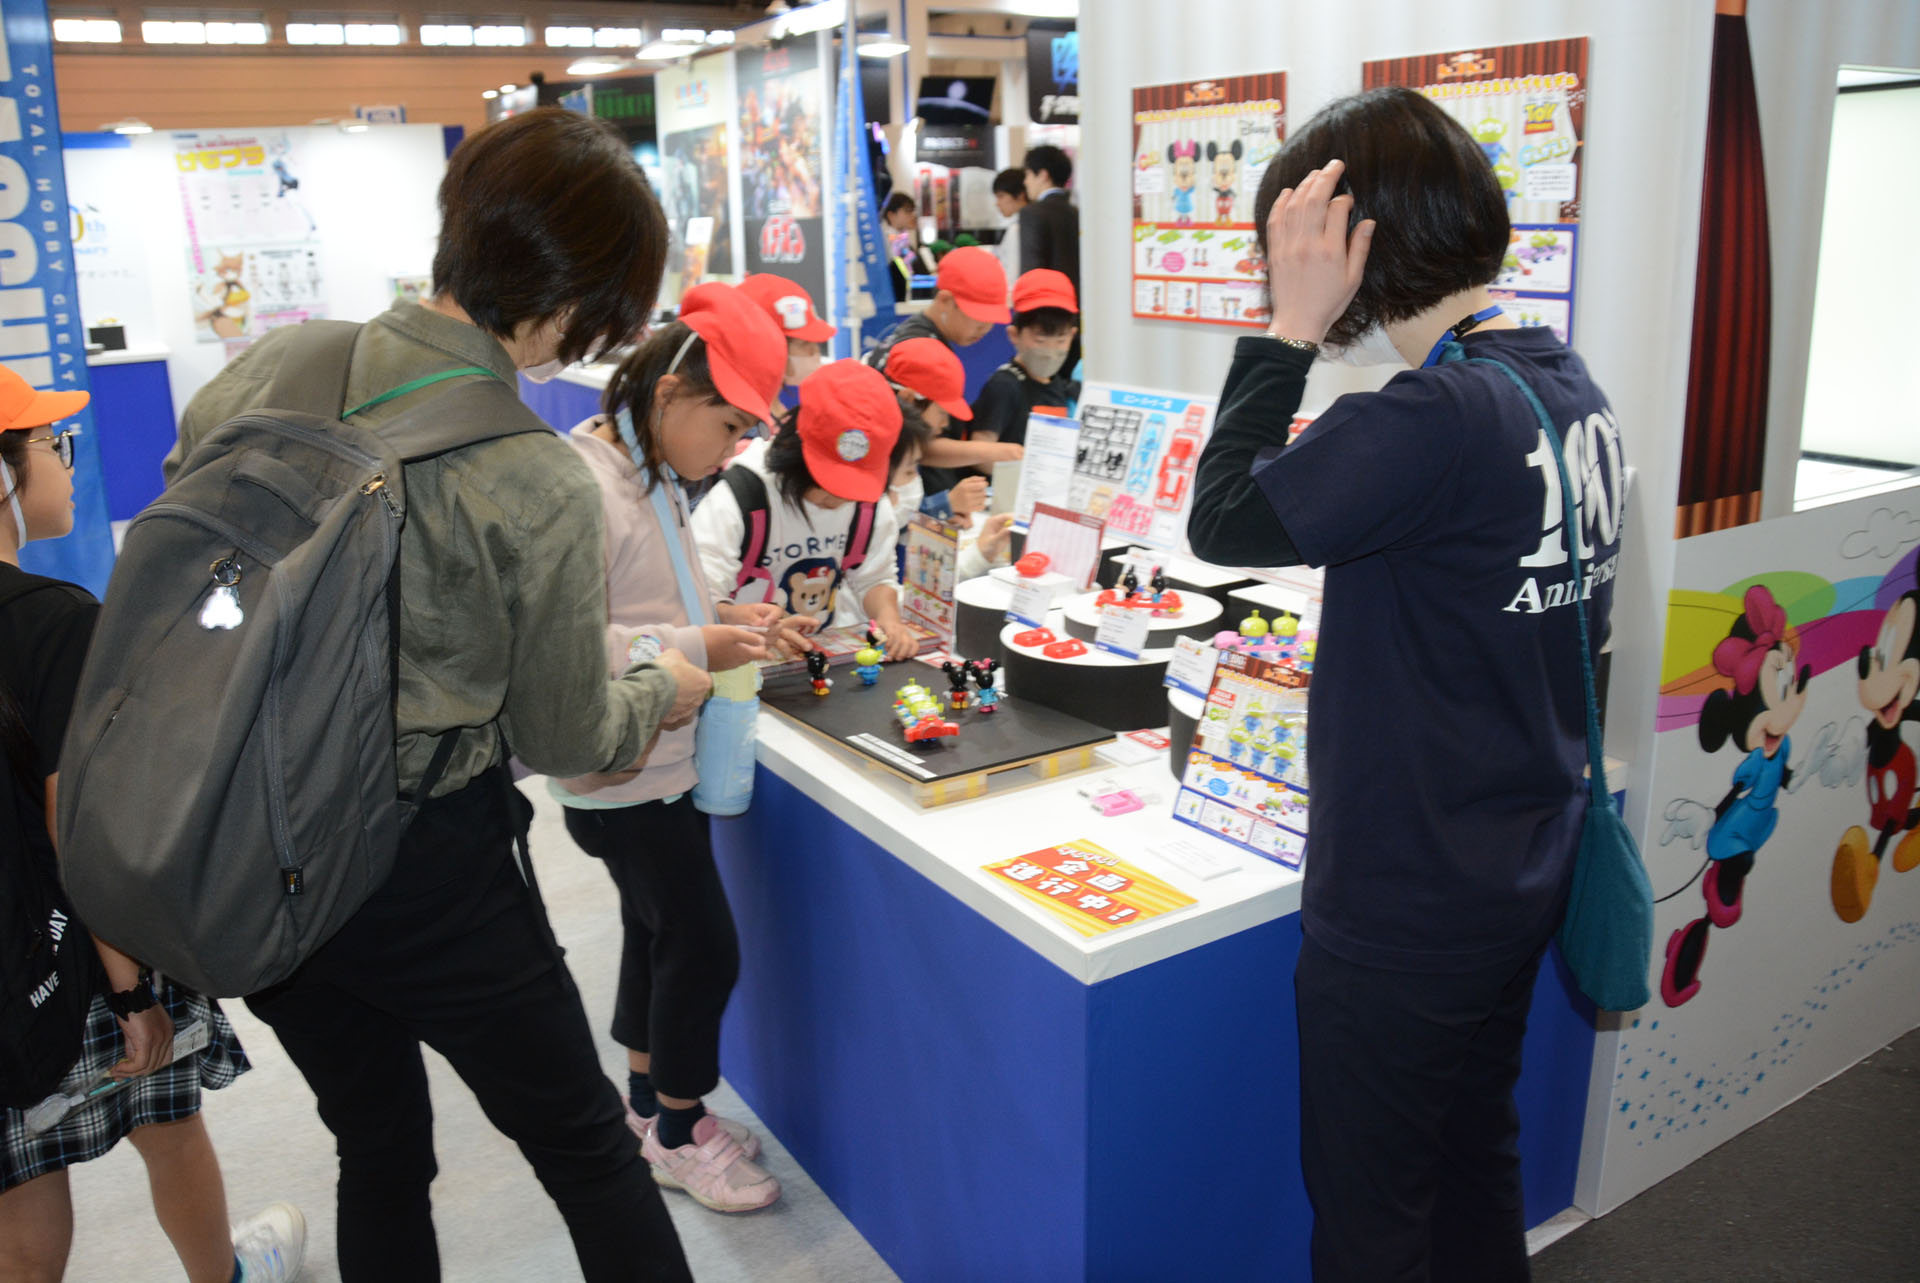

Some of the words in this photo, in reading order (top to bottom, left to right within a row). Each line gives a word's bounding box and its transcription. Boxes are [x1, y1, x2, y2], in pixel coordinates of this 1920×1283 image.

[1523, 102, 1559, 122] TOY
[22, 65, 48, 156] TOTAL
[36, 178, 65, 272] HOBBY
[1052, 859, 1129, 893] 企画
[29, 970, 60, 1009] HAVE
